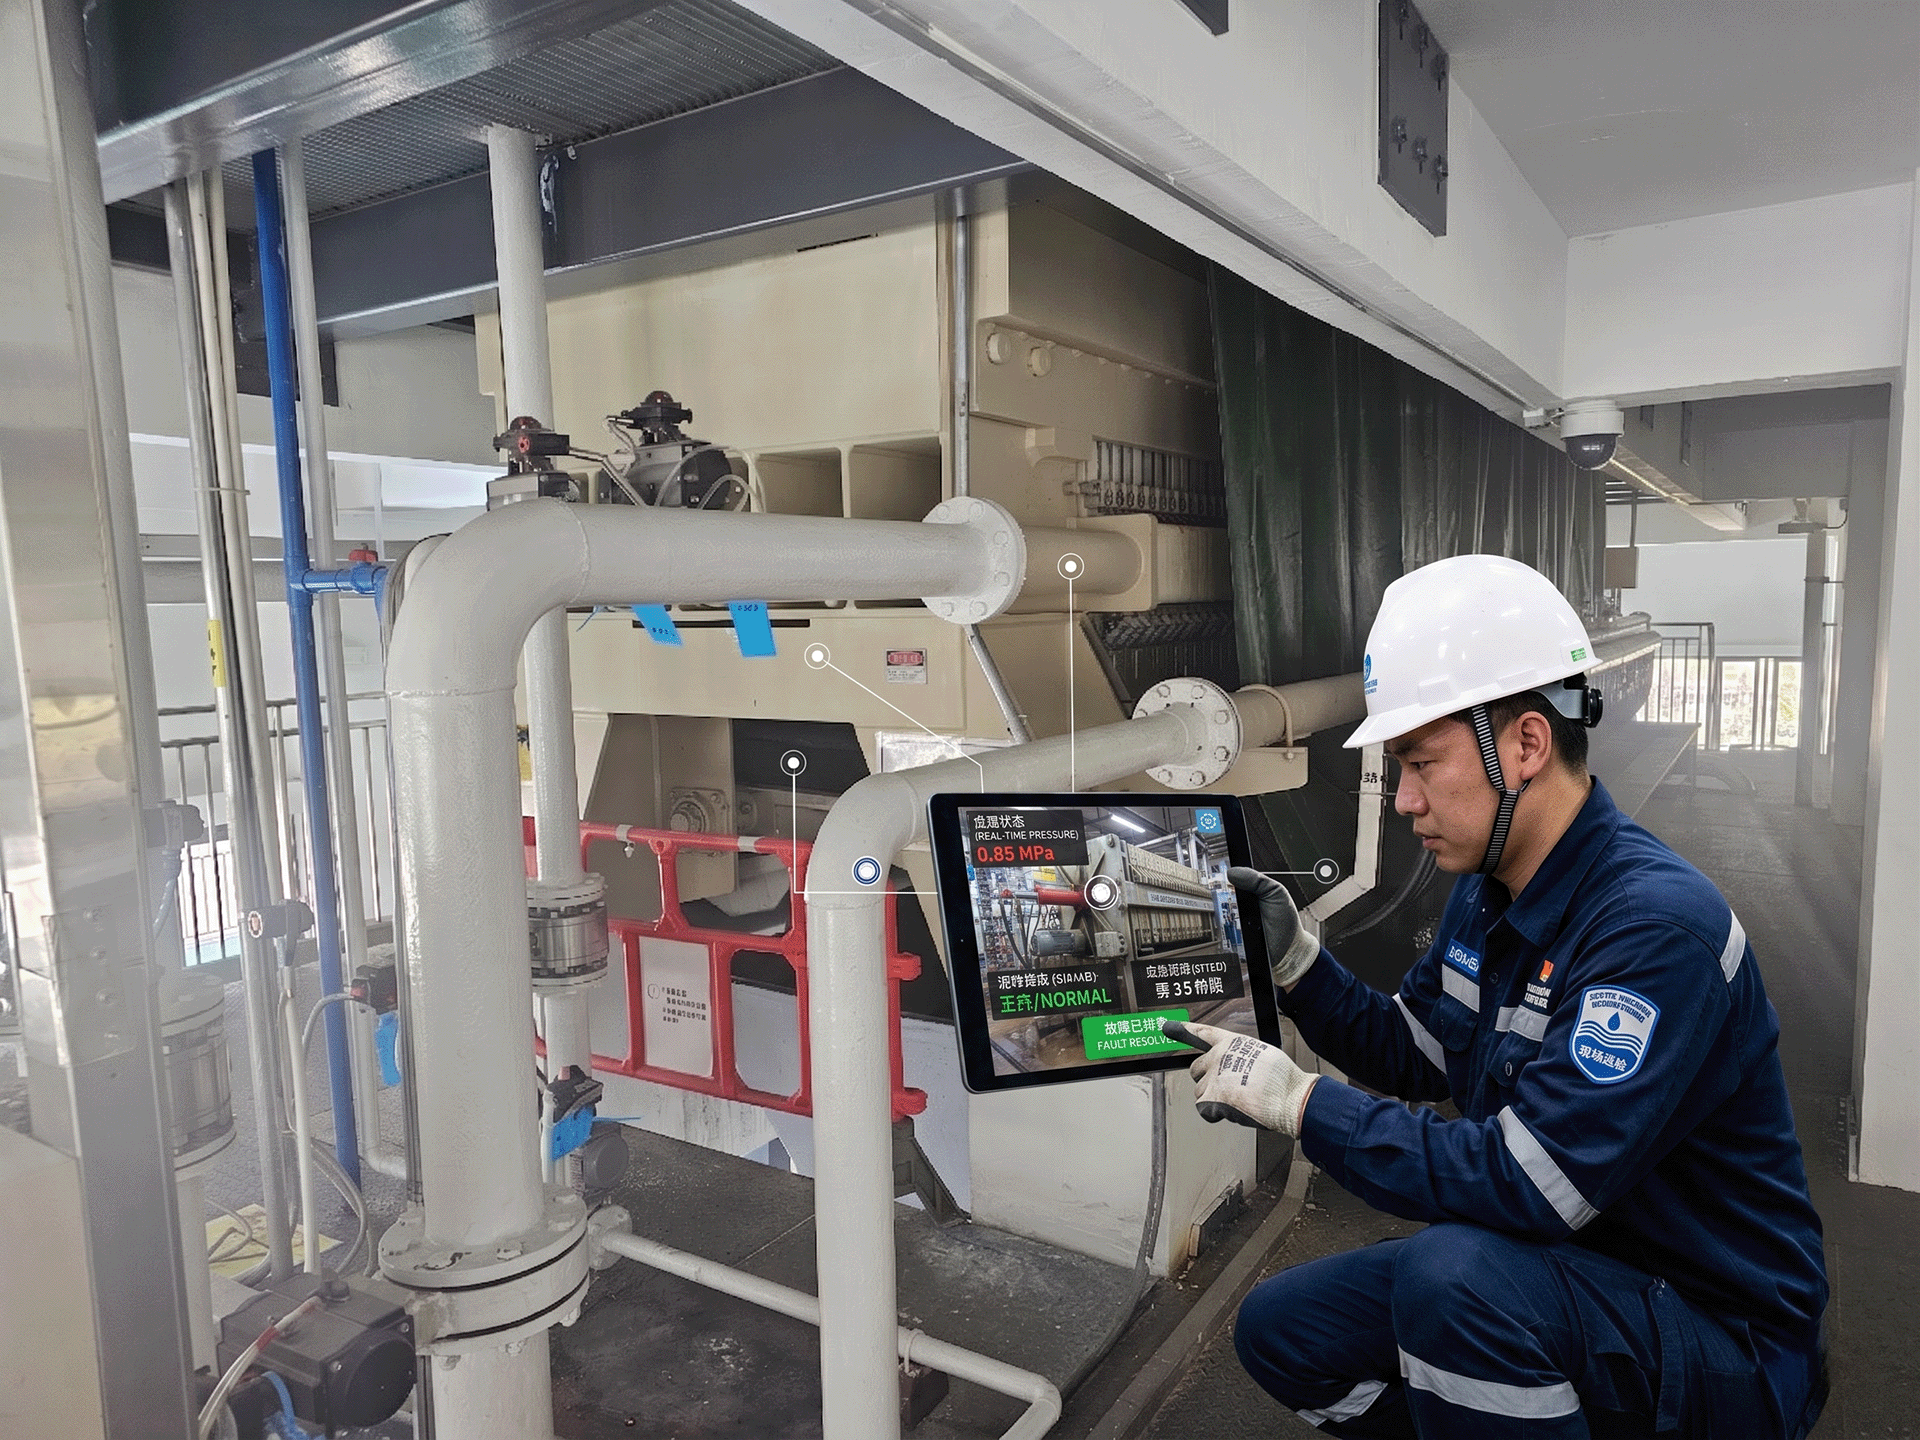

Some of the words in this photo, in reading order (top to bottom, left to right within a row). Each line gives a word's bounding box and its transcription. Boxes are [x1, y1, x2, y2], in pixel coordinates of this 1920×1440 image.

[975, 831, 1027, 841] (REAL-TIME
[1029, 830, 1079, 840] PRESSURE)
[977, 846, 1015, 862] 0.85
[1018, 845, 1055, 861] MPa
[1097, 1038, 1127, 1050] FAULT
[1129, 1034, 1178, 1048] RESOLVE
